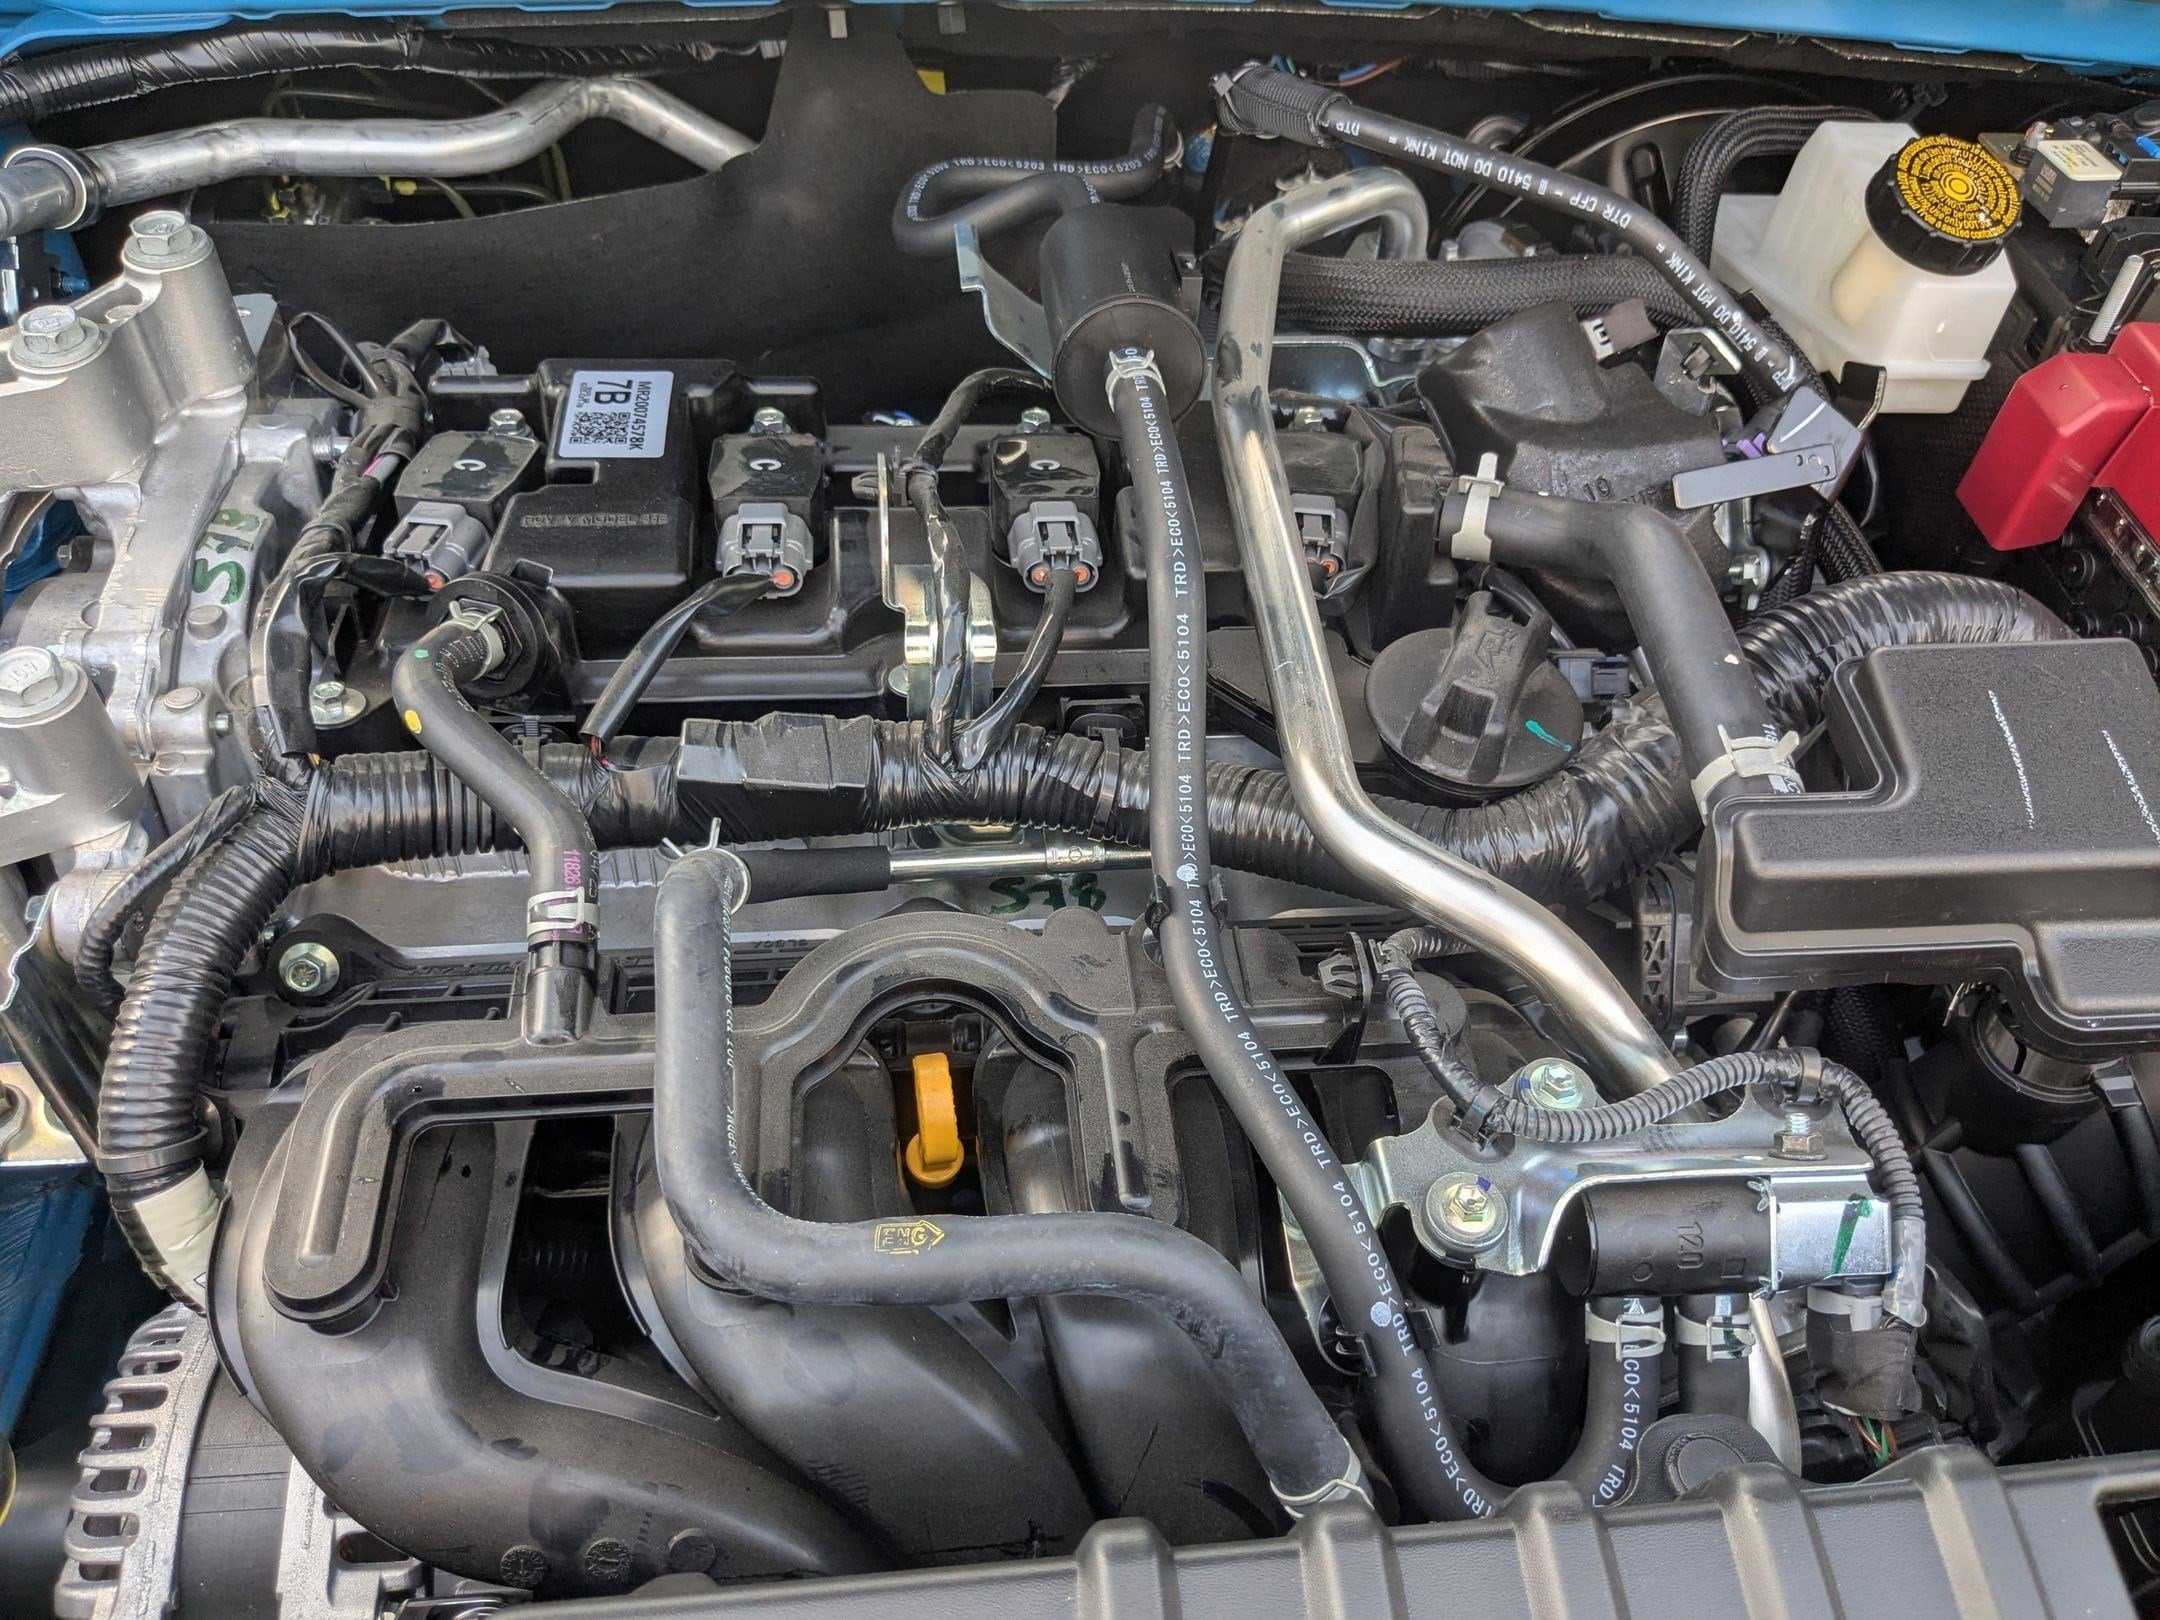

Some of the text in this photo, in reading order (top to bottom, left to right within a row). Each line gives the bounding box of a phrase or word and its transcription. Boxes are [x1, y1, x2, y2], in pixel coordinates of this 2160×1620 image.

[1403, 135, 1438, 161] KINK
[1442, 148, 1470, 172] NOT
[1497, 165, 1533, 191] 5410
[1569, 194, 1599, 213] CFP
[1601, 203, 1633, 230] DTR
[1665, 251, 1697, 286] KINK
[594, 379, 633, 405] 7B
[629, 381, 652, 450] MR20074578K
[1138, 396, 1170, 476] TRD>ECO<5104
[1159, 480, 1189, 598] TRD>ECO<5104
[1176, 612, 1192, 763] TRD>ECO<5104
[563, 849, 581, 885] 11826
[1188, 899, 1241, 1024] TRD>ECO<5104
[1237, 1030, 1332, 1170] TRD>ECO<5104
[1332, 1180, 1416, 1357] TRD>ECO<5104
